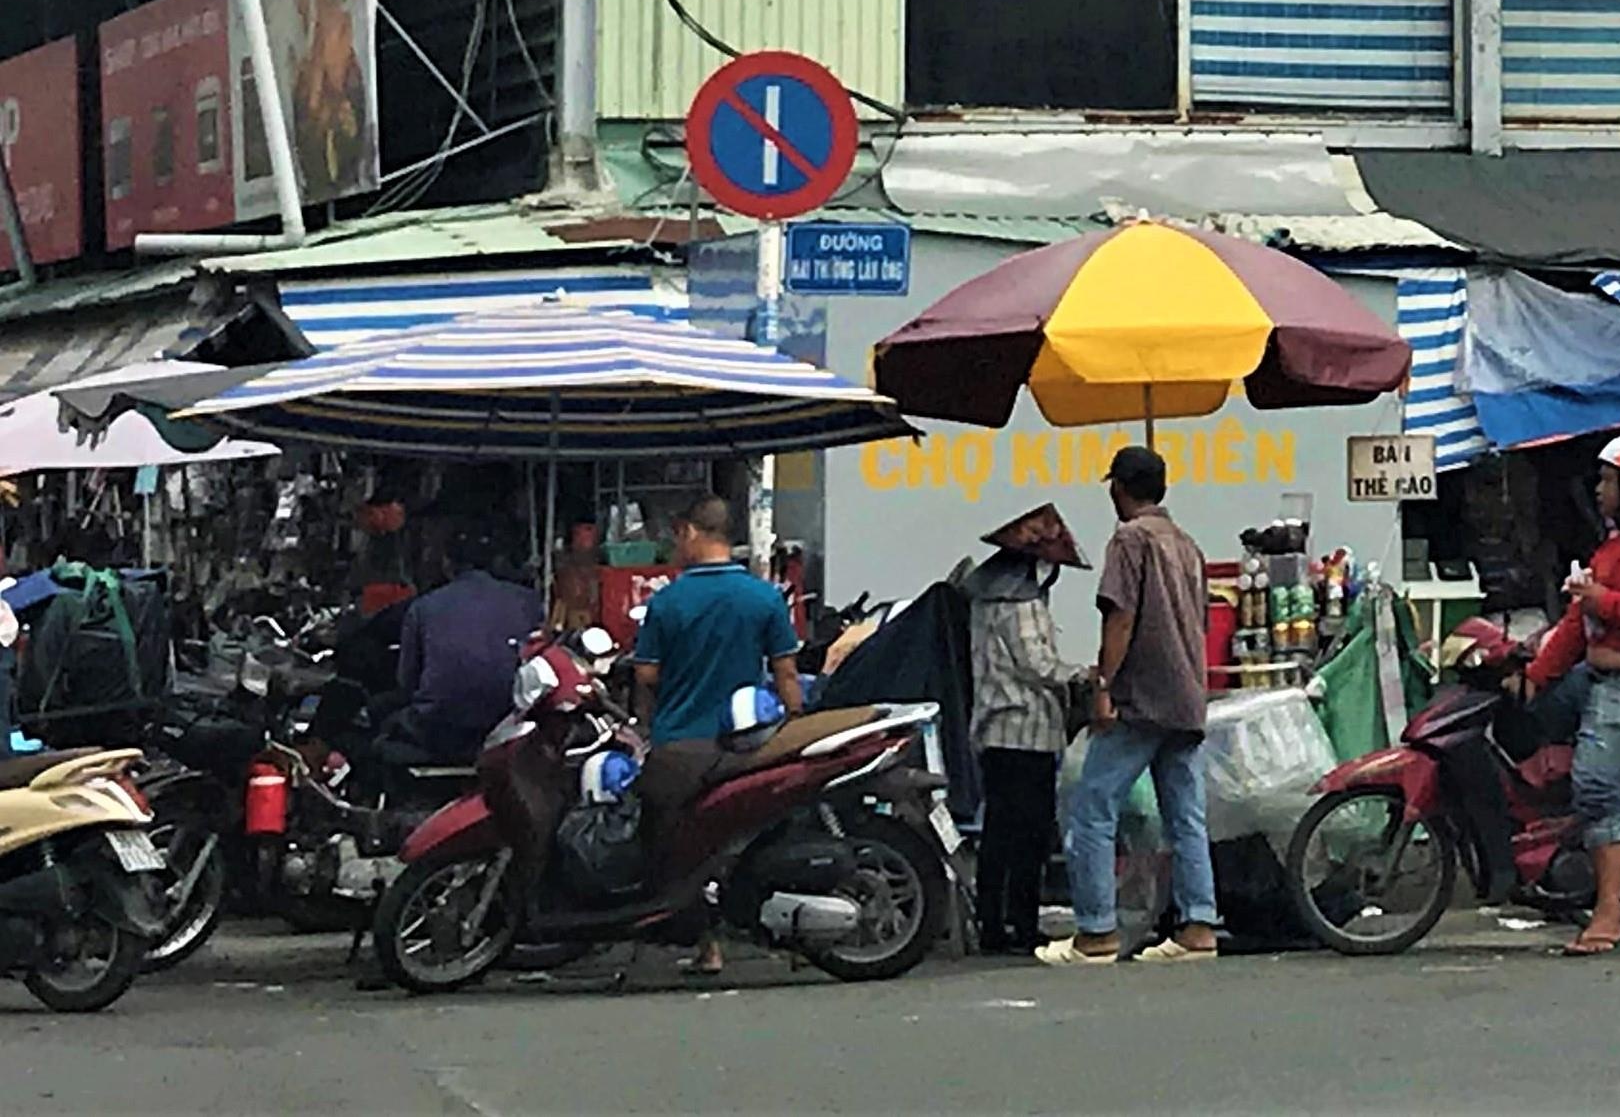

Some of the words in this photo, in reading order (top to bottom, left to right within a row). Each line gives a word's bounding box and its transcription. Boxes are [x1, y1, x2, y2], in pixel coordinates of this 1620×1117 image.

[859, 428, 996, 503] CHỢ
[1011, 429, 1132, 487] KIM
[1150, 417, 1295, 484] BIÊN
